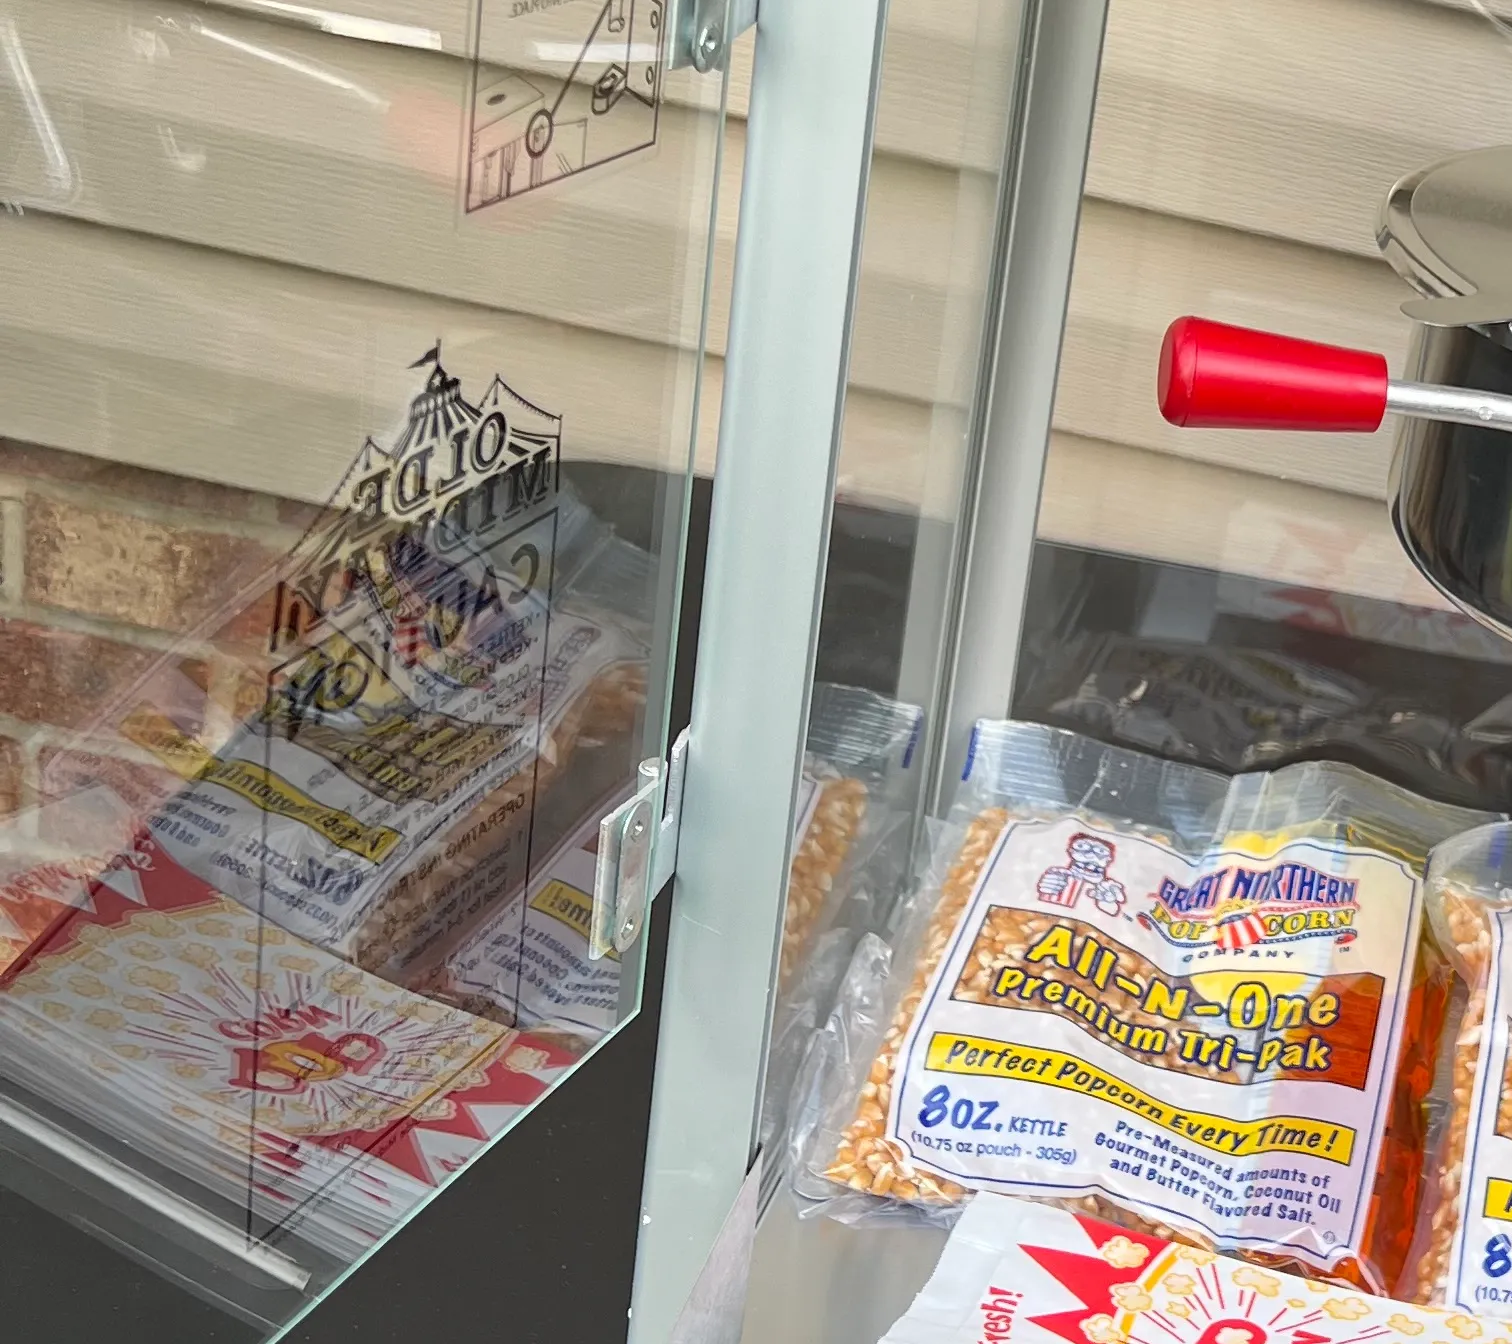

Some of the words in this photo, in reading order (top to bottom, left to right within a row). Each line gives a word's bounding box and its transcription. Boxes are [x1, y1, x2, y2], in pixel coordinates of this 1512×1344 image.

[1182, 946, 1295, 964] COMPANY
[1263, 908, 1356, 937] CORN
[1024, 923, 1342, 1030] All-N-One
[994, 965, 1169, 1055] Premium
[1178, 1029, 1334, 1073] Tri-Pak
[946, 1040, 1052, 1076] Perfect
[1056, 1060, 1164, 1121] Popcorn
[1168, 1113, 1249, 1153] Every
[1256, 1122, 1339, 1152] Time!
[1008, 1116, 1069, 1137] KETTLE
[911, 1130, 952, 1152] (10.75
[956, 1141, 973, 1153] oz
[976, 1142, 1022, 1158] pouch
[1095, 1131, 1168, 1166] Gourmet
[1170, 1158, 1241, 1202] Popcorn,
[1243, 1185, 1314, 1204] Coconut
[1317, 1193, 1342, 1214] Oil
[1115, 1119, 1233, 1181] Pre-Measured
[1235, 1168, 1308, 1185] amounts
[1311, 1172, 1332, 1189] of
[1110, 1156, 1141, 1178] and
[1145, 1167, 1198, 1199] Butter
[1201, 1194, 1272, 1219] Flavored
[1276, 1203, 1316, 1226] Salt.
